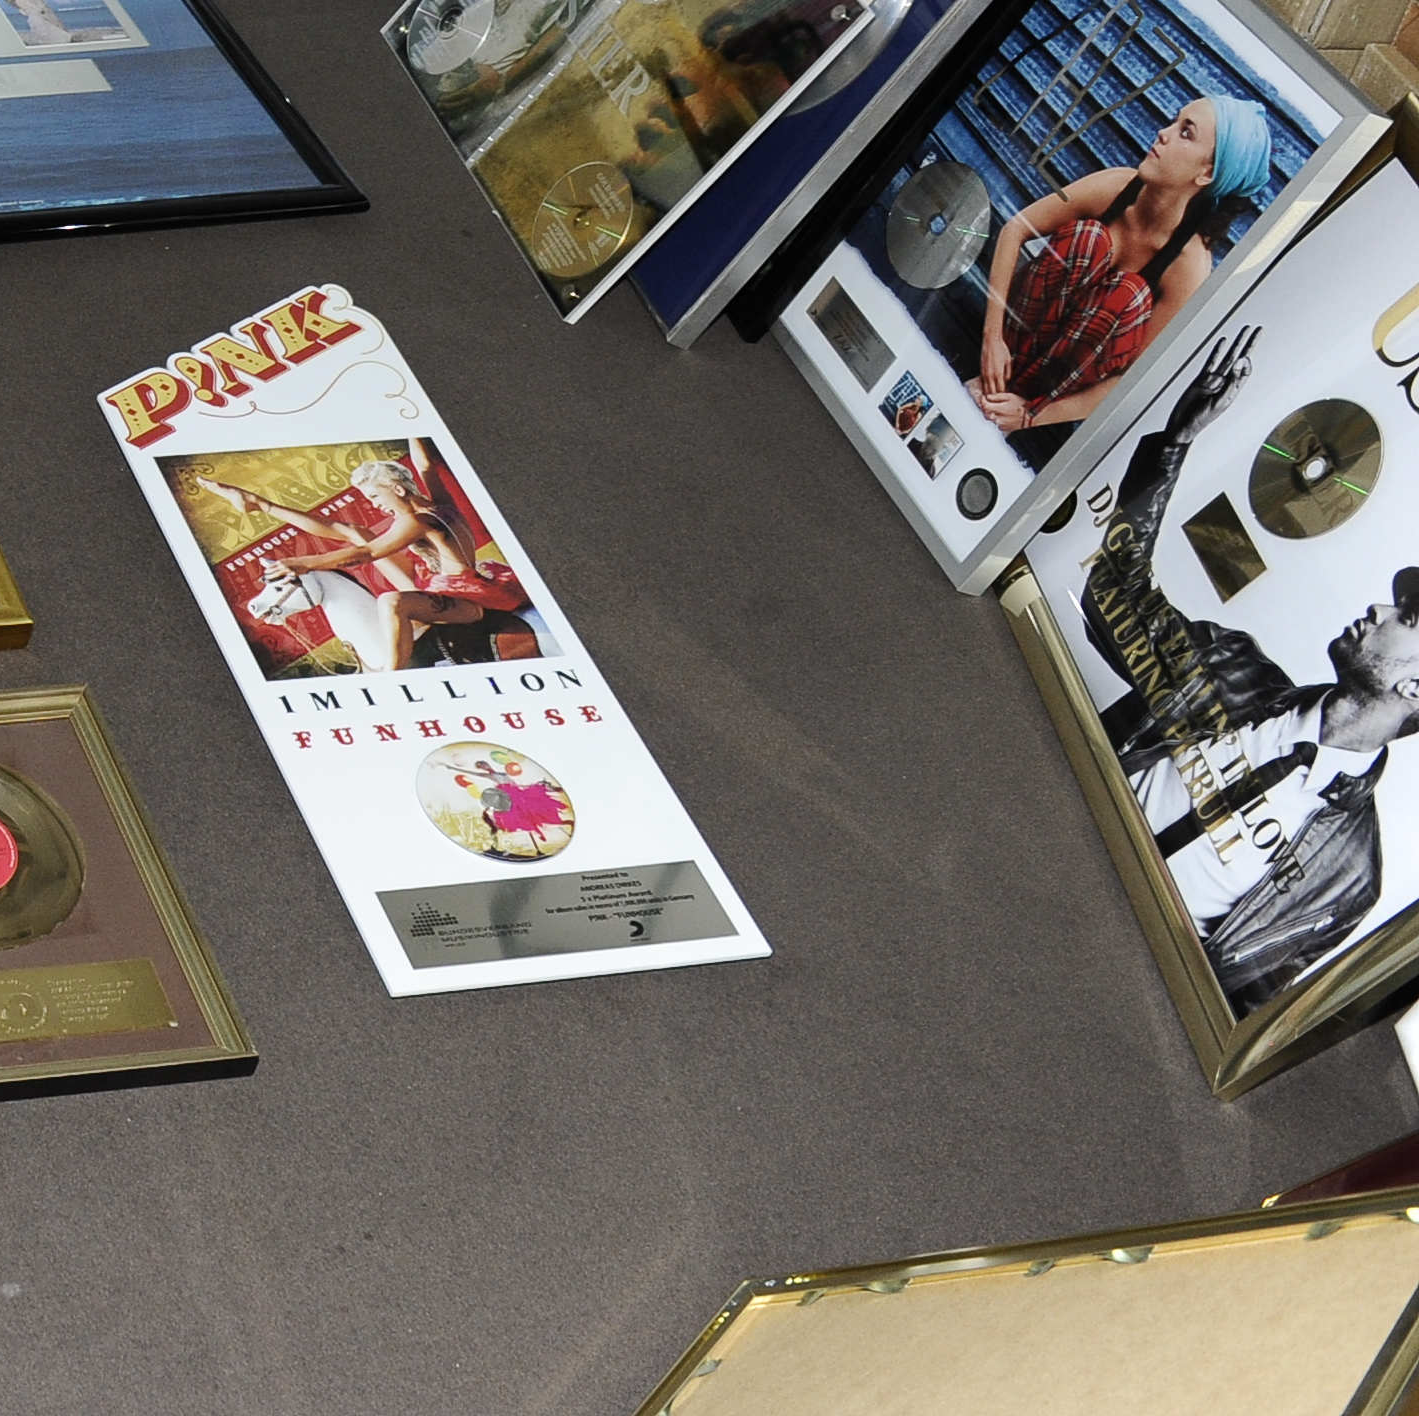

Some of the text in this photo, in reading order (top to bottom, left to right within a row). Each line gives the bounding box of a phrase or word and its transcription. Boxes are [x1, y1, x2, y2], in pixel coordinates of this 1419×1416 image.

[225, 527, 299, 573] FUNHOUSE
[309, 668, 585, 711] MILLION
[1086, 482, 1123, 530] DJ
[1238, 794, 1307, 896] LOVE
[293, 705, 603, 749] FUNHOUSE
[1163, 719, 1246, 867] PITBULL
